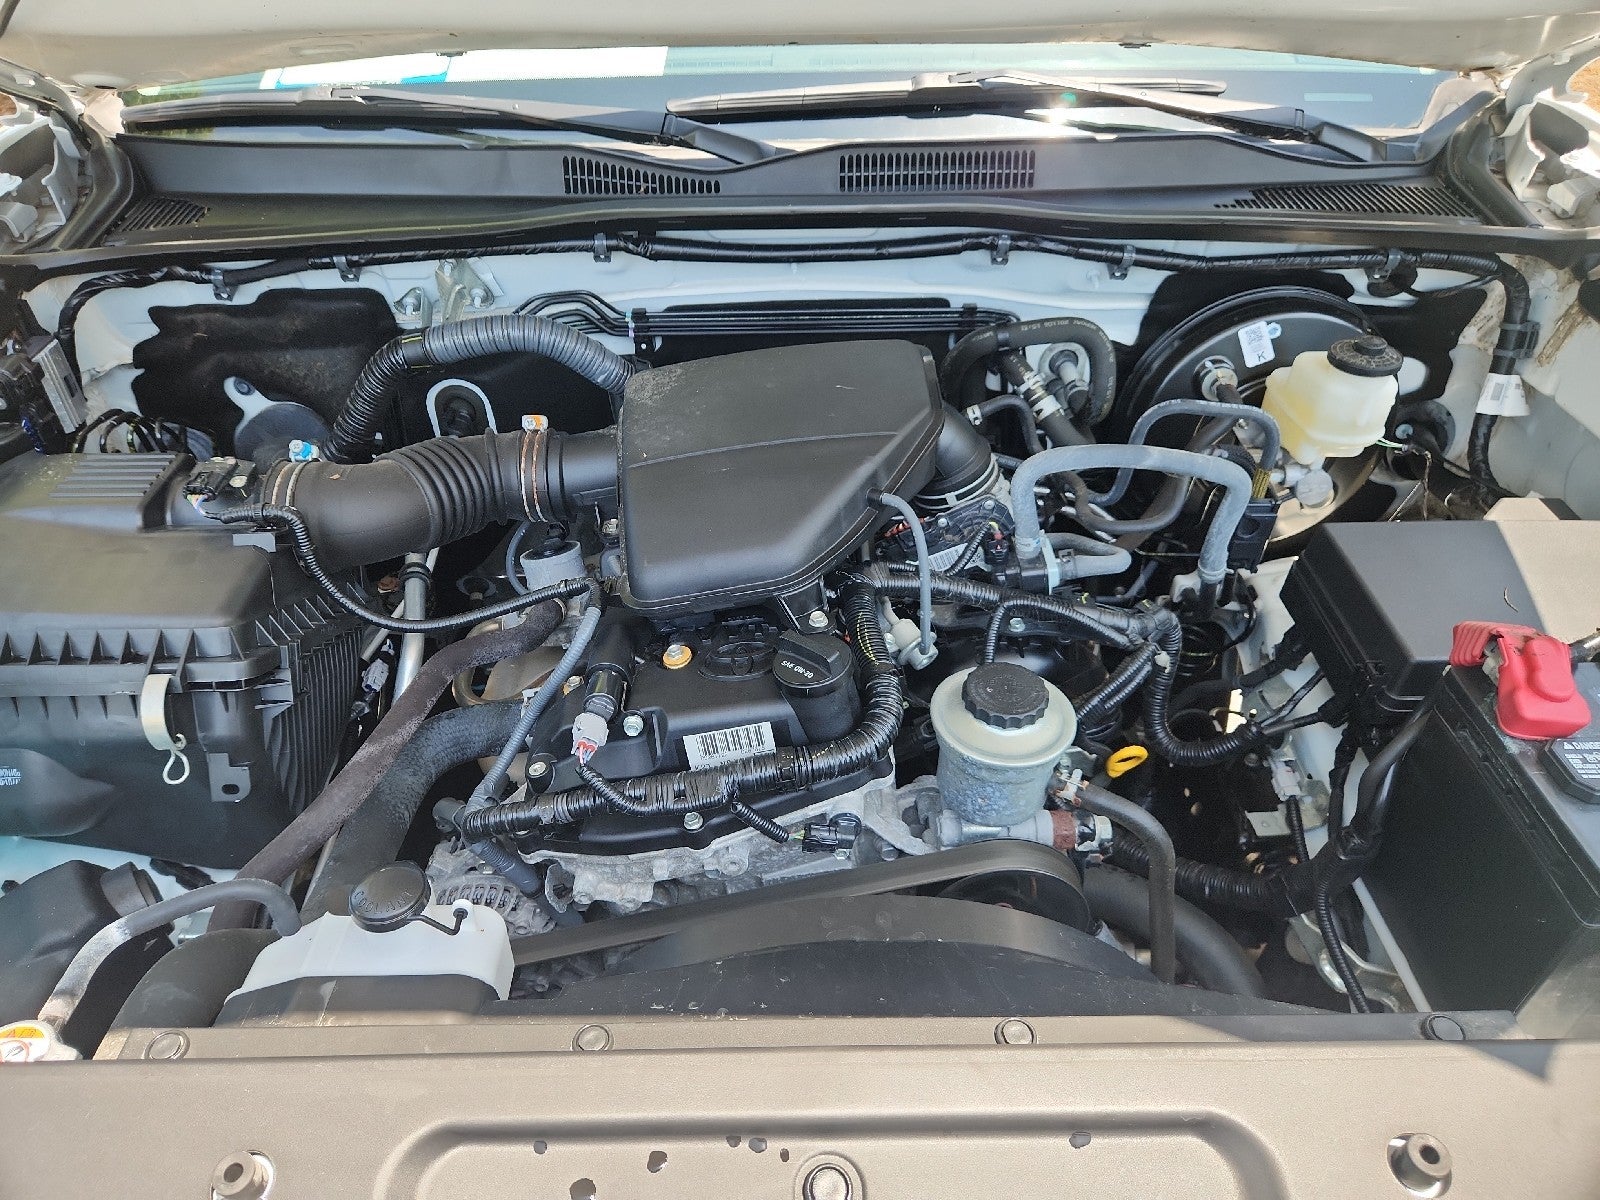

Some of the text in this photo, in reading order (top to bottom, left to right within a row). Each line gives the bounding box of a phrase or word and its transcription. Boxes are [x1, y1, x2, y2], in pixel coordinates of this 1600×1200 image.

[780, 660, 814, 679] SAE 0W-20
[1571, 741, 1600, 750] DANGE
[353, 888, 414, 915] COOLANT
